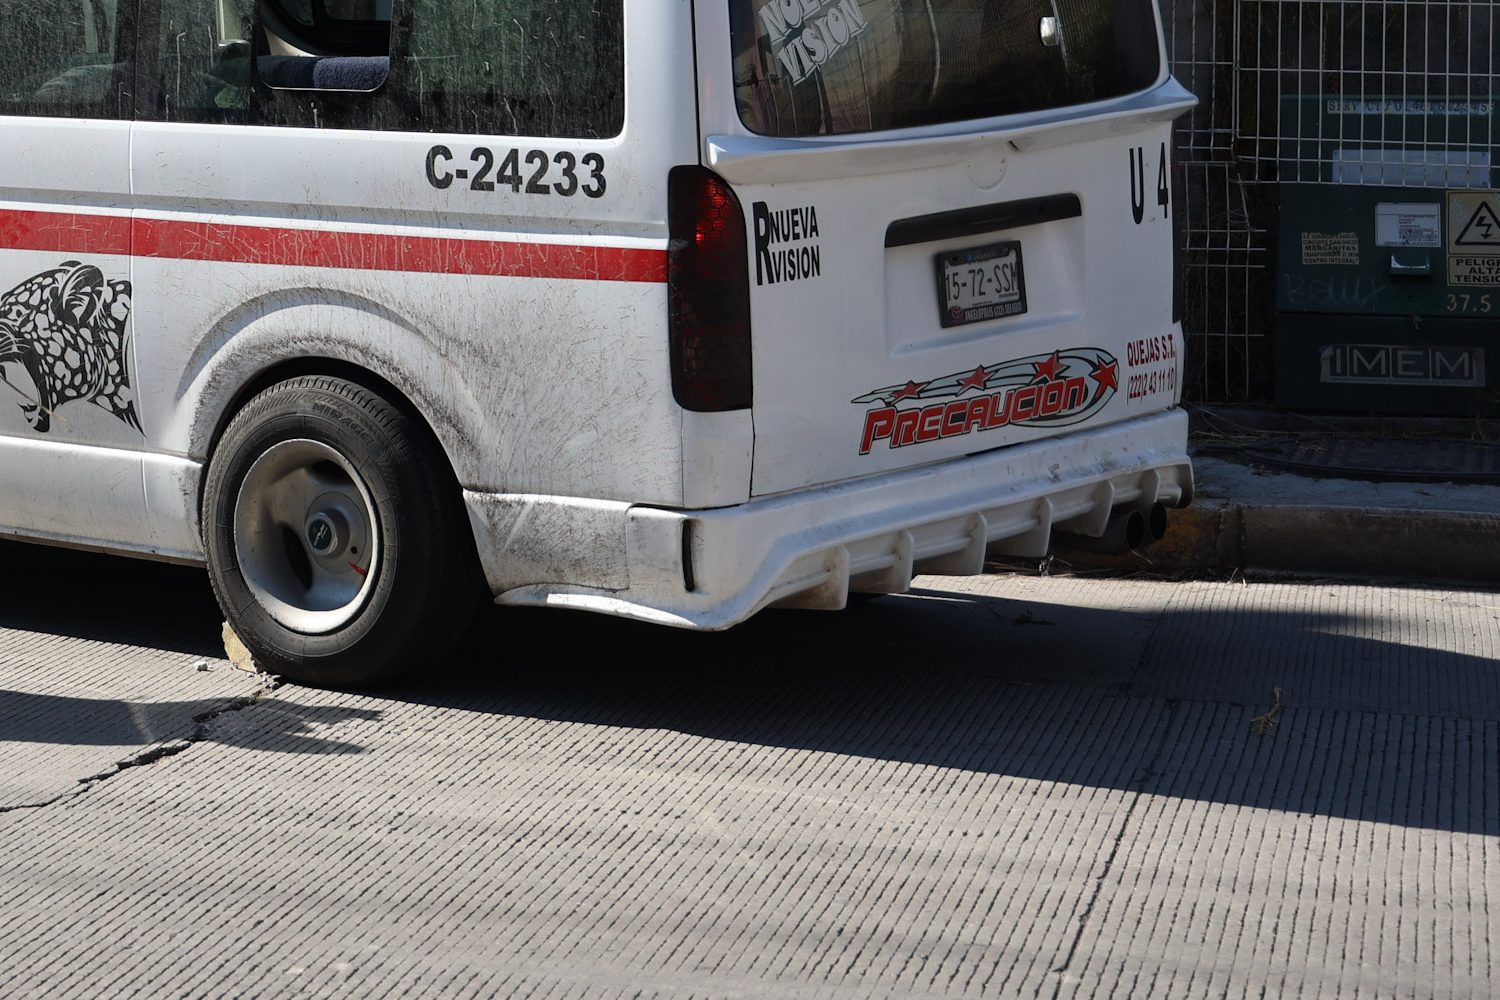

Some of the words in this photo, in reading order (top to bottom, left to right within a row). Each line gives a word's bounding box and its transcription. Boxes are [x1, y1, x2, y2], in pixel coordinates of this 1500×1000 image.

[425, 144, 607, 198] C-24233
[1129, 147, 1144, 224] U
[1157, 142, 1168, 219] 4
[770, 206, 819, 244] NUEVA
[772, 245, 820, 283] VISION
[1447, 293, 1492, 312] 37.5
[1127, 336, 1160, 368] QUEJAS
[1335, 347, 1470, 378] IMEM
[312, 402, 374, 446] MIRAGE
[859, 375, 1088, 457] PRECAUCION
